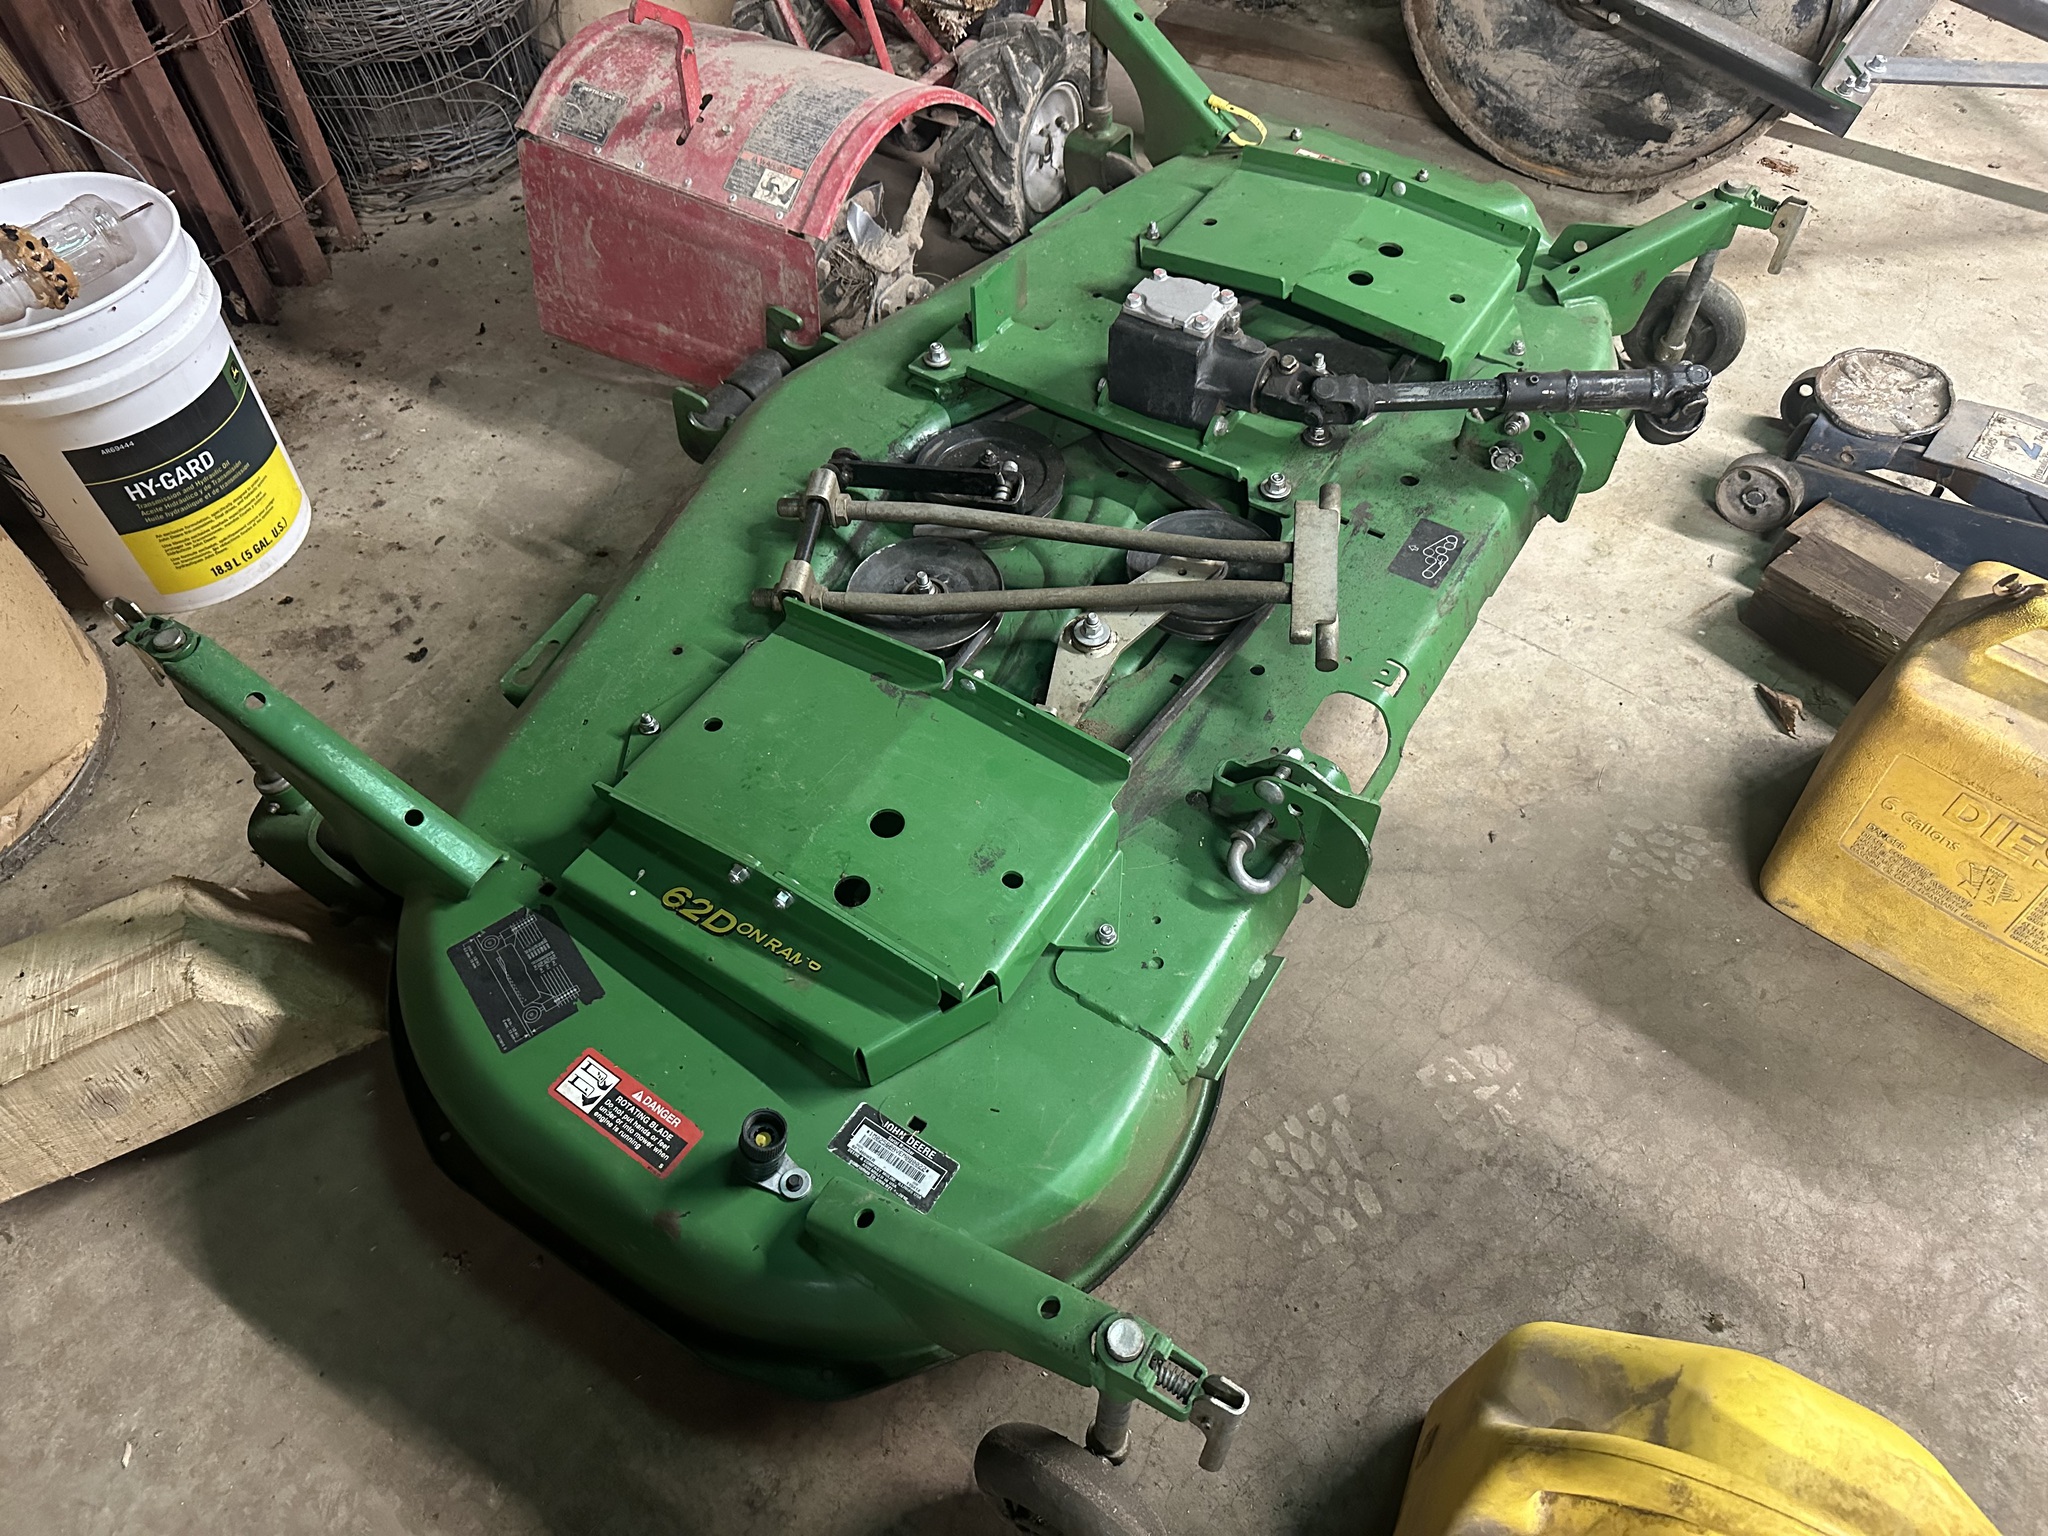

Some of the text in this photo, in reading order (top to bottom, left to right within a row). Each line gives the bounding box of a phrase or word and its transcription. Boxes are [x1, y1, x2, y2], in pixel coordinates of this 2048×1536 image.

[100, 440, 135, 456] AR69444
[2004, 436, 2043, 460] 2
[124, 450, 214, 502] HY-GARD
[136, 460, 230, 510] Transmission and Hydraulic Oil
[144, 514, 164, 523] Huile
[164, 498, 204, 518] hydraulique
[212, 488, 220, 496] de
[220, 462, 250, 490] transmission
[140, 506, 164, 516] Aceite
[204, 484, 212, 492] de
[210, 516, 288, 576] 18.9 L (5 GAL. U.S.)
[1866, 822, 1908, 851] DANGER
[1880, 796, 1961, 852] 6 Gallons
[661, 886, 738, 934] 62D
[736, 922, 768, 944] ON
[594, 1111, 614, 1128] engine
[618, 1130, 642, 1150] running
[599, 1106, 617, 1120] under
[622, 1122, 635, 1134] into
[634, 1132, 654, 1148] mower
[652, 1146, 670, 1160] when
[604, 1099, 671, 1151] Do not put hands or feet
[616, 1096, 674, 1142] ROTATING BLADE
[642, 1096, 682, 1128] DANGER
[882, 1120, 938, 1160] JOHN DEERE
[888, 1136, 915, 1156] Serial Number
